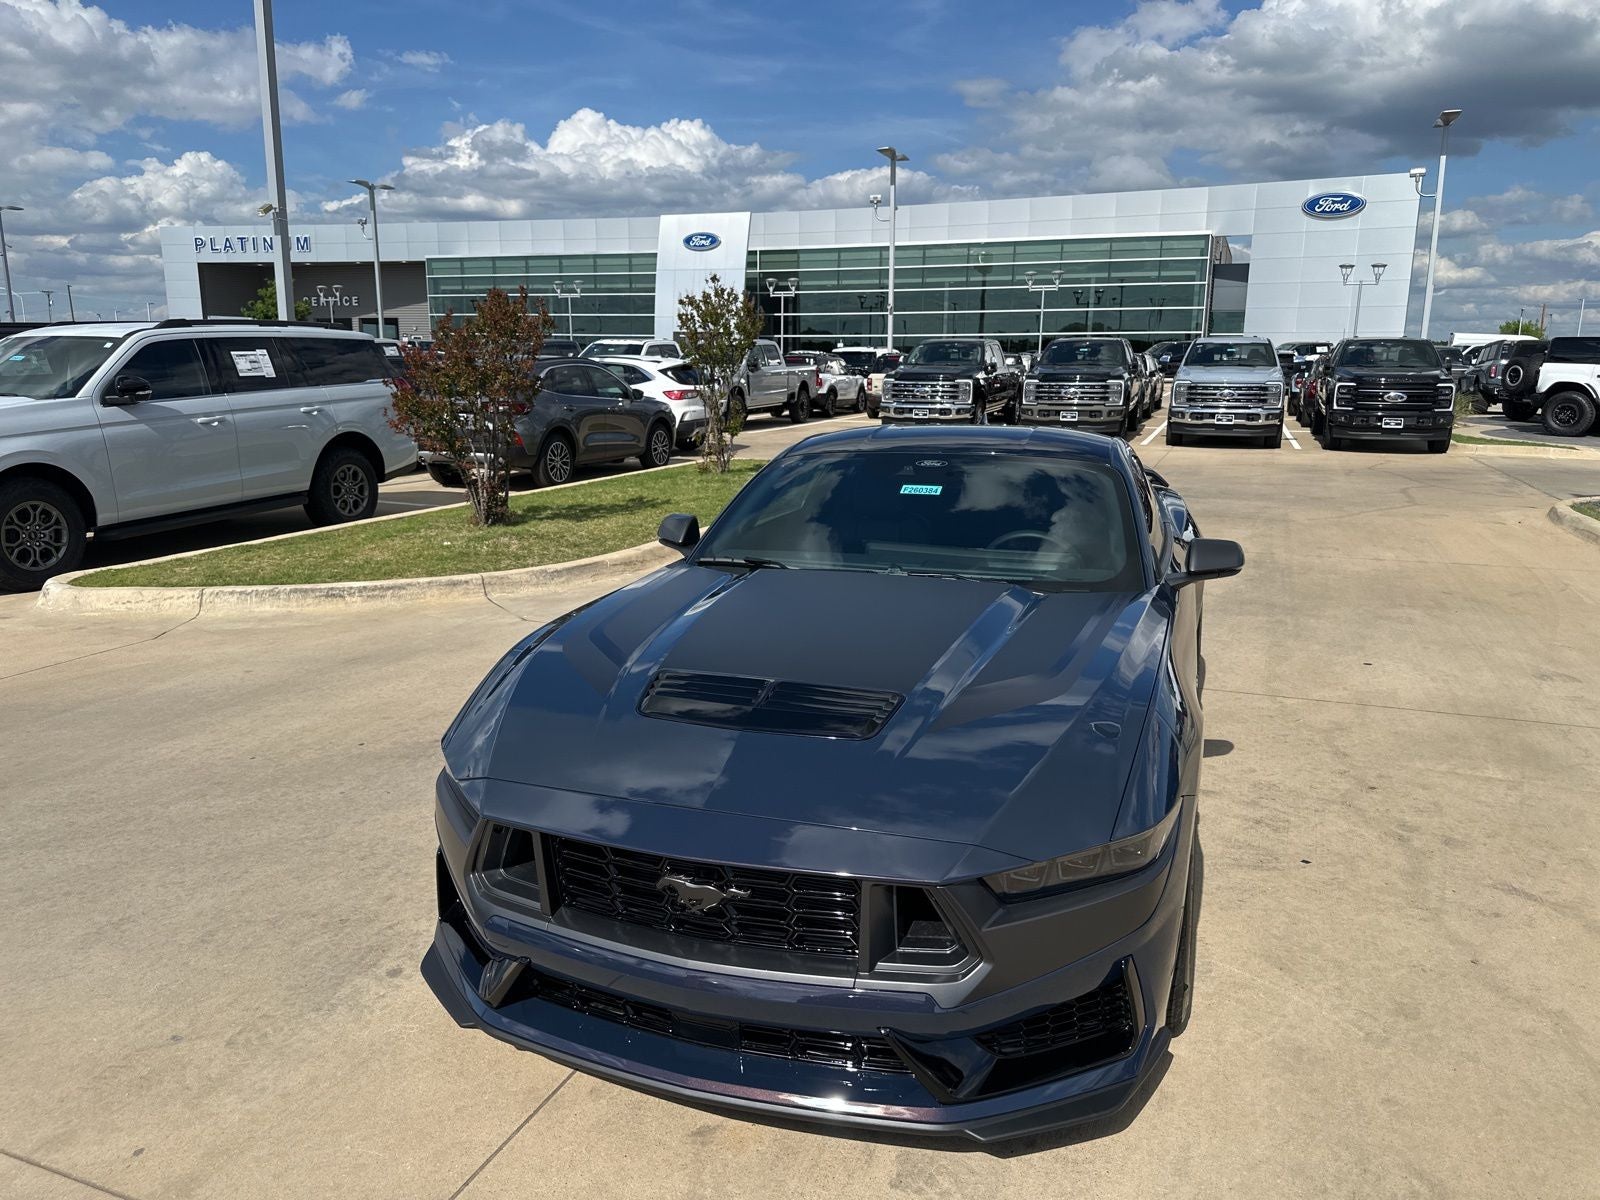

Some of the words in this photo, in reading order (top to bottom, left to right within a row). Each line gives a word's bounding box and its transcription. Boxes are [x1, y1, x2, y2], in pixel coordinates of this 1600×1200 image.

[1315, 197, 1351, 212] Ford
[194, 236, 310, 252] PLATINM
[689, 235, 712, 246] Ford
[902, 486, 939, 494] F260384
